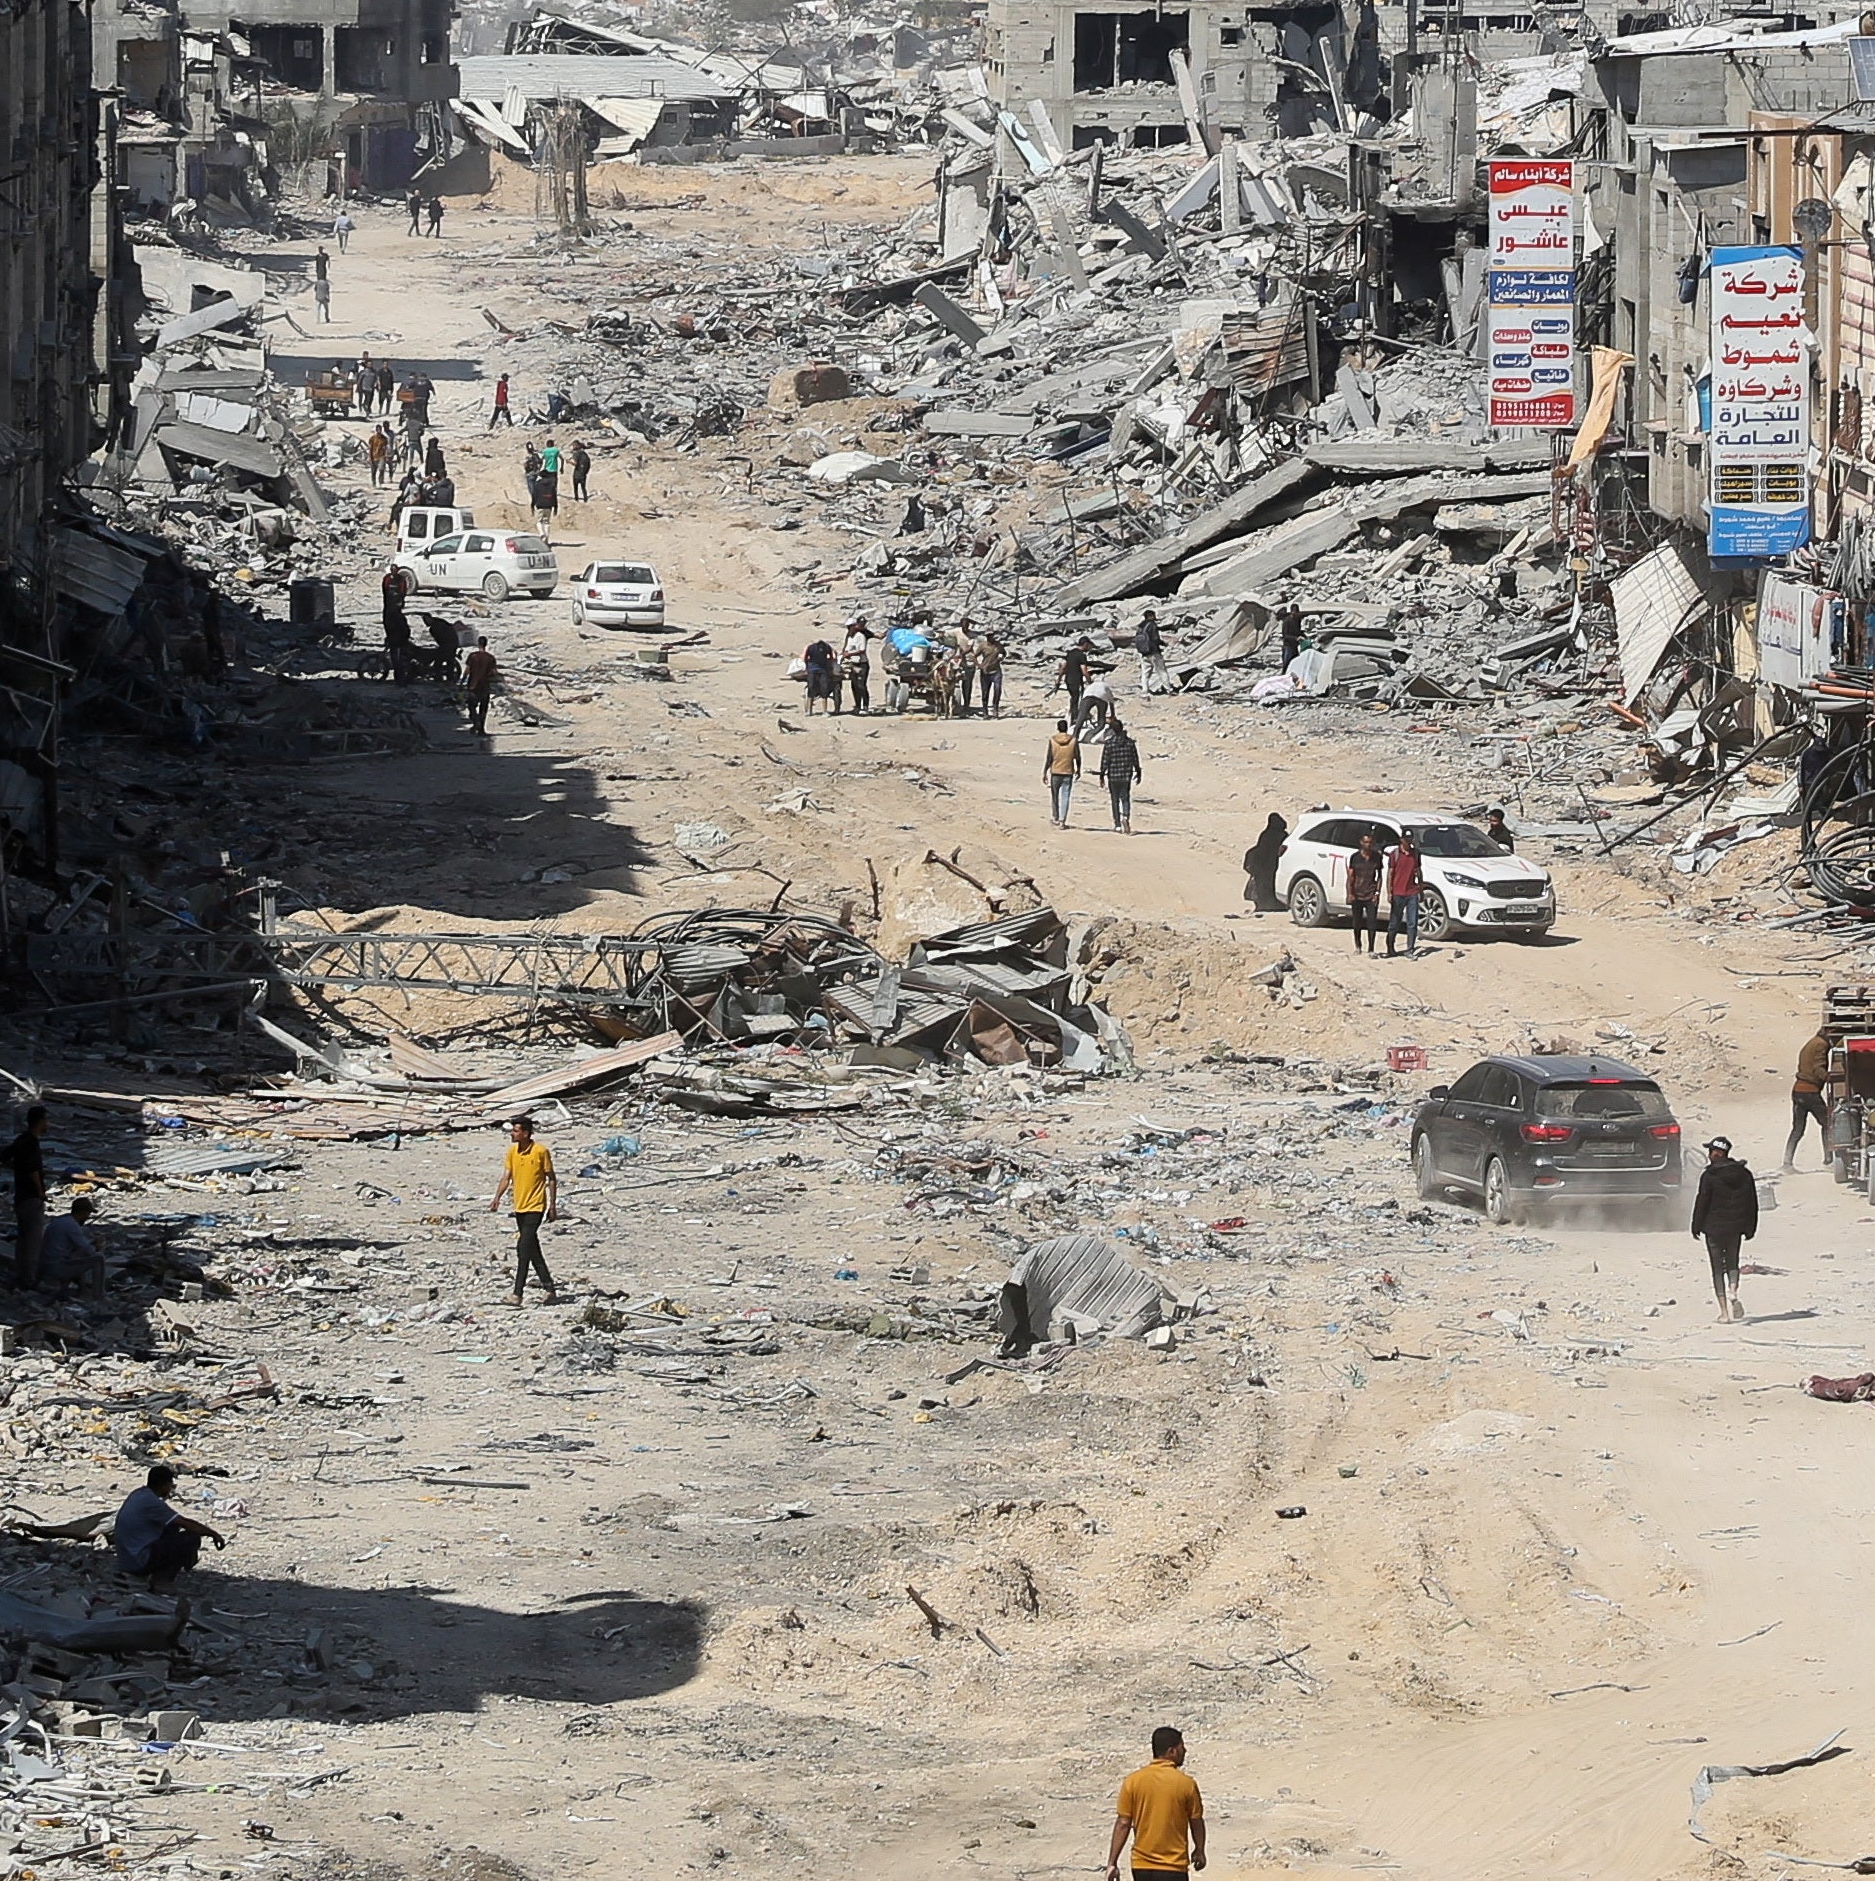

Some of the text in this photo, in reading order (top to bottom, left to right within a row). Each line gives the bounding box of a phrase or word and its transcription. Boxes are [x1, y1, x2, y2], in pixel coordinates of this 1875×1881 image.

[1495, 166, 1570, 183] شركة أبناء سالم
[1497, 204, 1569, 222] عيسى
[1496, 228, 1569, 253] عاشور
[1496, 272, 1569, 287] لكافة لوازم
[1721, 268, 1798, 301] شركة
[1720, 305, 1802, 336] نعيم
[1721, 338, 1801, 370] شموط
[1719, 405, 1799, 427] للتجارة
[1715, 429, 1799, 445] العامة
[428, 563, 447, 576] UN
[1416, 816, 1443, 824] TV
